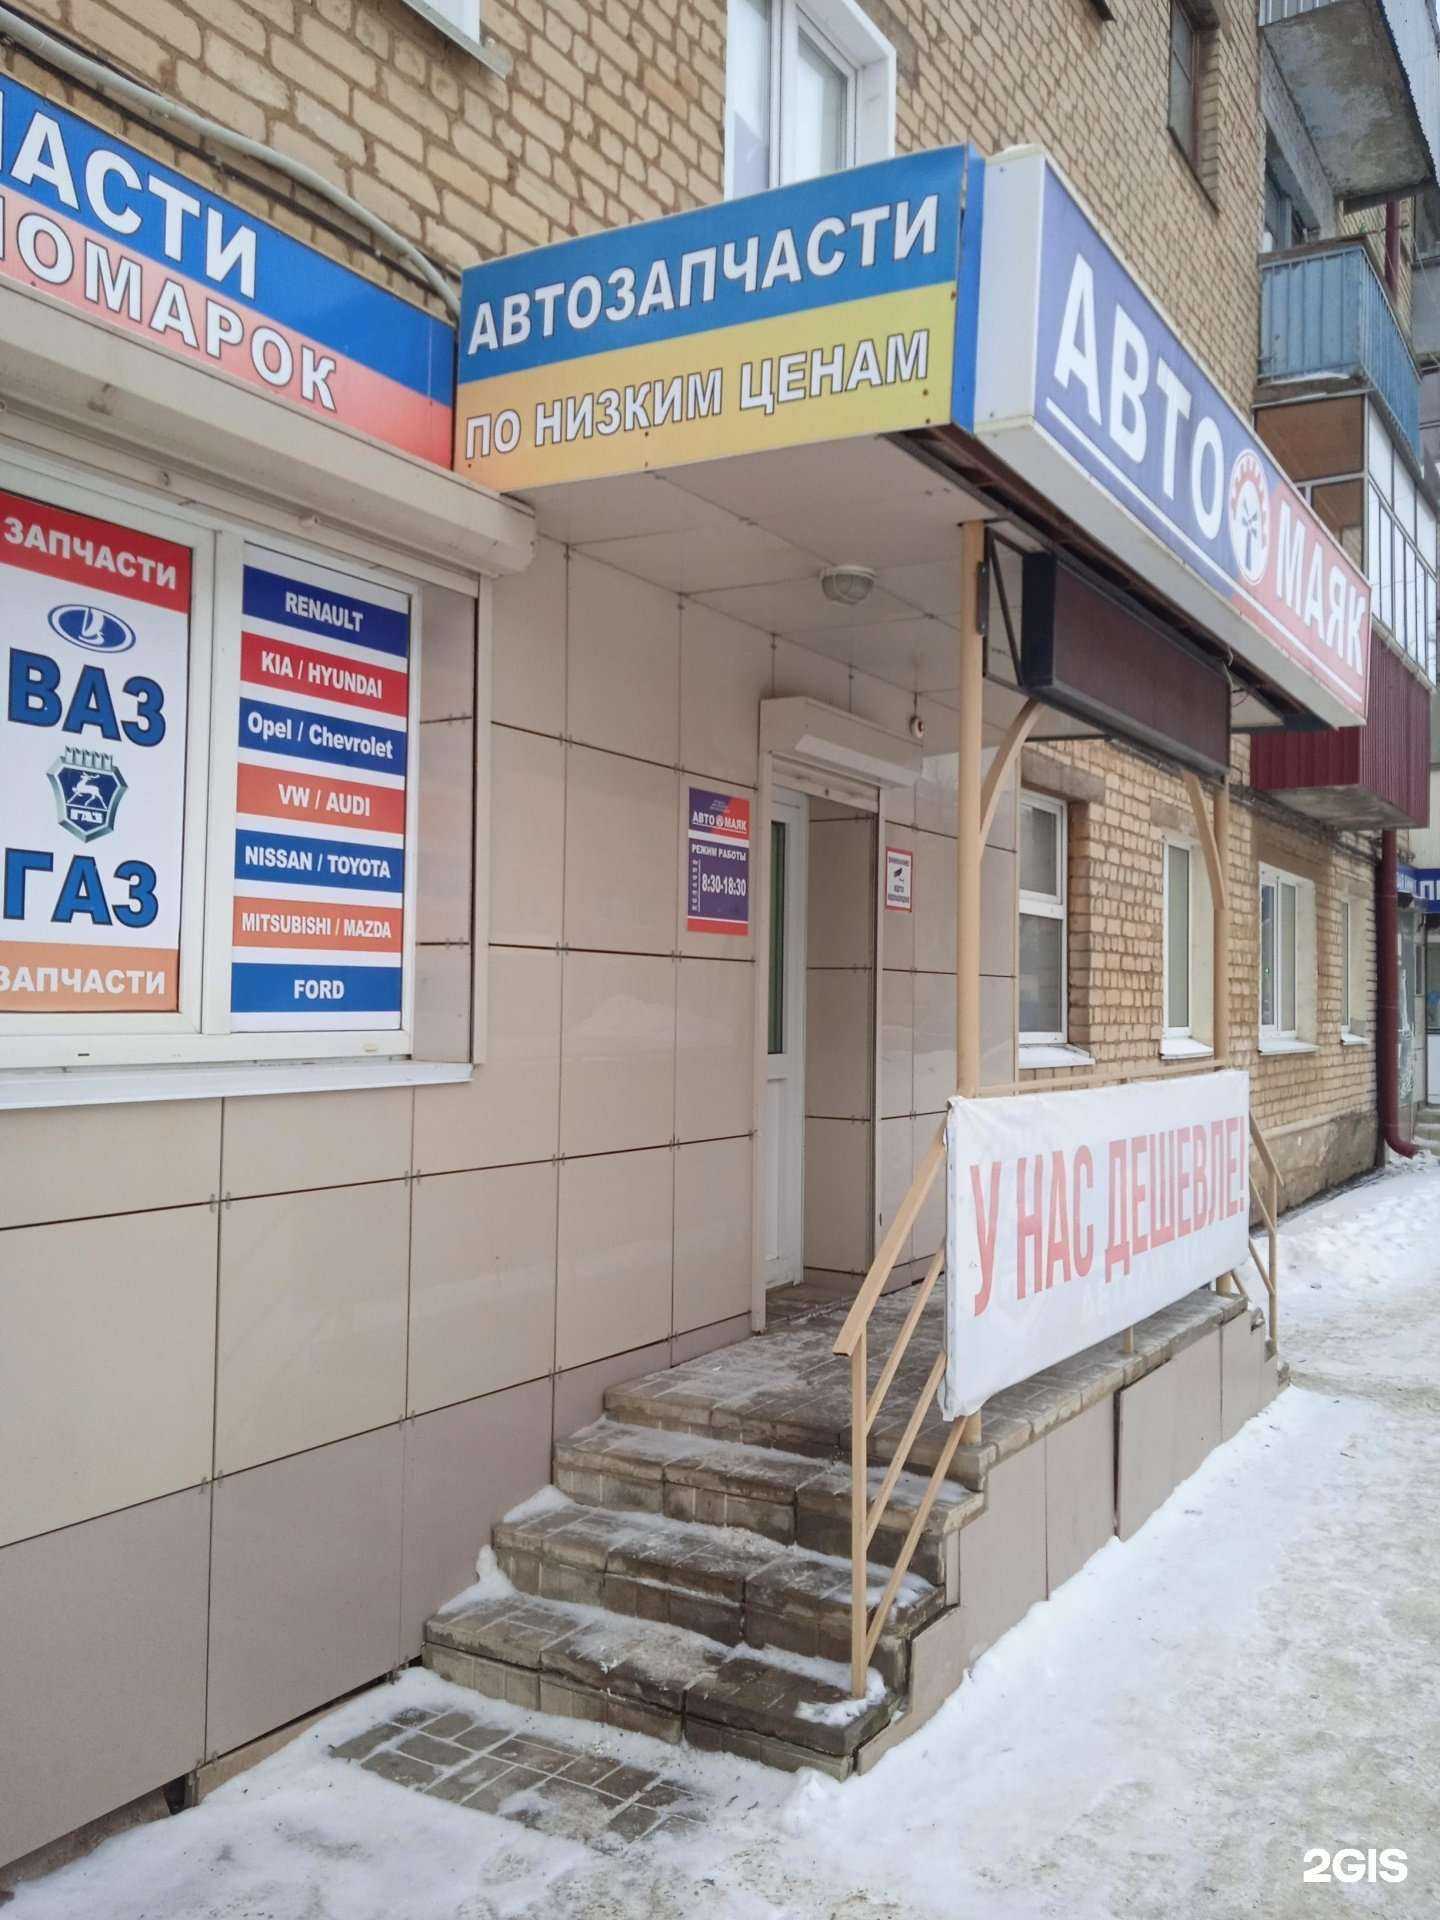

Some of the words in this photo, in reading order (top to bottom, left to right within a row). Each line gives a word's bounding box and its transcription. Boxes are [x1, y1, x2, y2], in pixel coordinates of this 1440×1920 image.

[0, 91, 257, 299] АСТИ
[467, 194, 939, 356] АВТОЗАПЧАСТИ
[0, 195, 337, 412] ОМАРОК
[465, 409, 521, 460] ПО
[534, 367, 723, 447] НИЗКИМ
[740, 329, 929, 415] ЦЕНАМ
[1054, 252, 1225, 541] АВТО
[1275, 499, 1366, 677] МАЯК
[4, 517, 176, 590] ЗАПЧАСТИ
[285, 591, 363, 632] RENAULT
[8, 647, 166, 747] ВАЗ
[261, 651, 293, 678] KIA
[308, 663, 383, 699] HYUNDAI
[248, 712, 292, 740] Opel
[309, 724, 393, 759] Chevrolet
[278, 784, 310, 808] VW
[326, 792, 370, 816] AUDI
[693, 811, 715, 826] АВТО
[724, 817, 747, 832] МАЯК
[245, 846, 313, 870] NISSAN
[327, 855, 391, 878] TOYOTA
[692, 844, 717, 857] РЕЖИМ
[718, 847, 747, 861] РАБОТЫ
[3, 847, 159, 928] ГАЗ
[702, 873, 747, 896] 8:30-18:30
[242, 913, 331, 936] MITSUBISHI
[344, 919, 391, 938] MAZDA
[0, 965, 166, 995] ЗАПЧАСТИ
[294, 980, 345, 999] FORD
[970, 1161, 1002, 1317] У
[1016, 1145, 1094, 1300] НАС
[1105, 1116, 1245, 1283] ДЕШЕВЛЕ!
